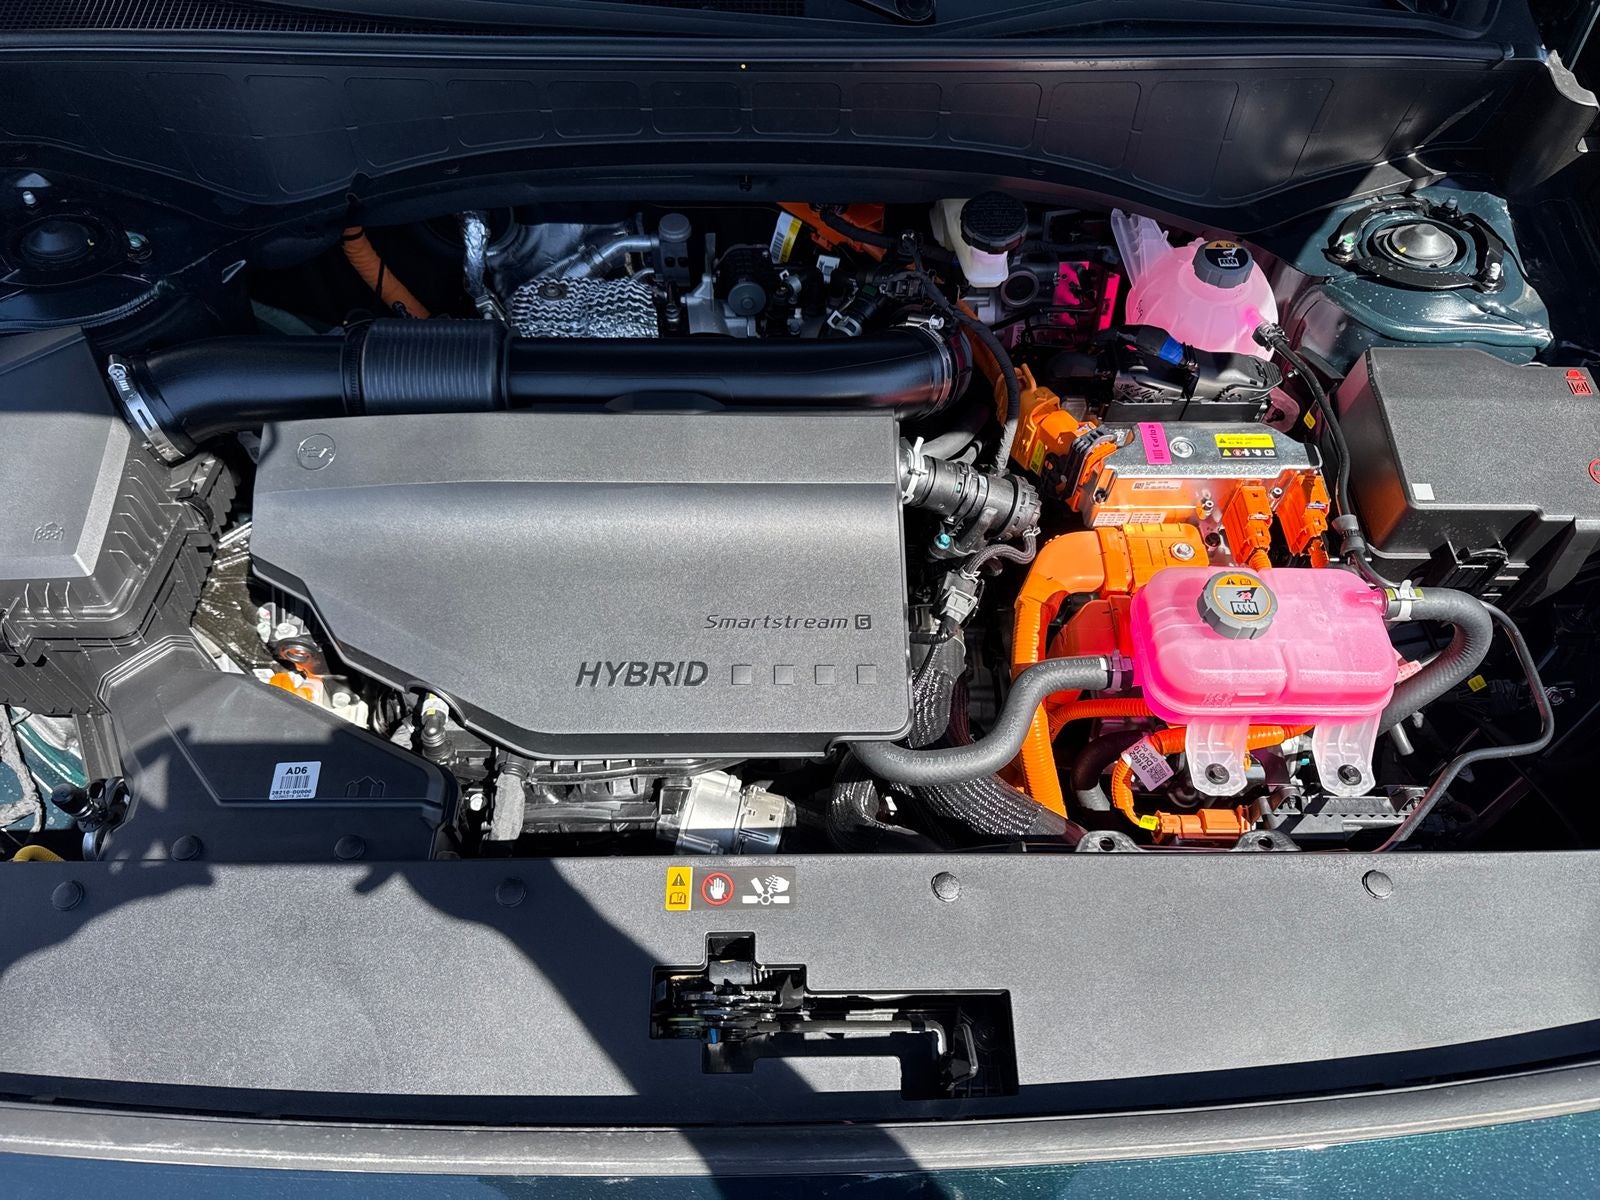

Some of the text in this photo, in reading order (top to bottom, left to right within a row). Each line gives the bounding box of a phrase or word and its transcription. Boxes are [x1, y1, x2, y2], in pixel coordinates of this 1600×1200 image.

[703, 614, 872, 630] Smartstream G
[575, 660, 709, 688] HYBRID
[286, 766, 308, 775] AD6
